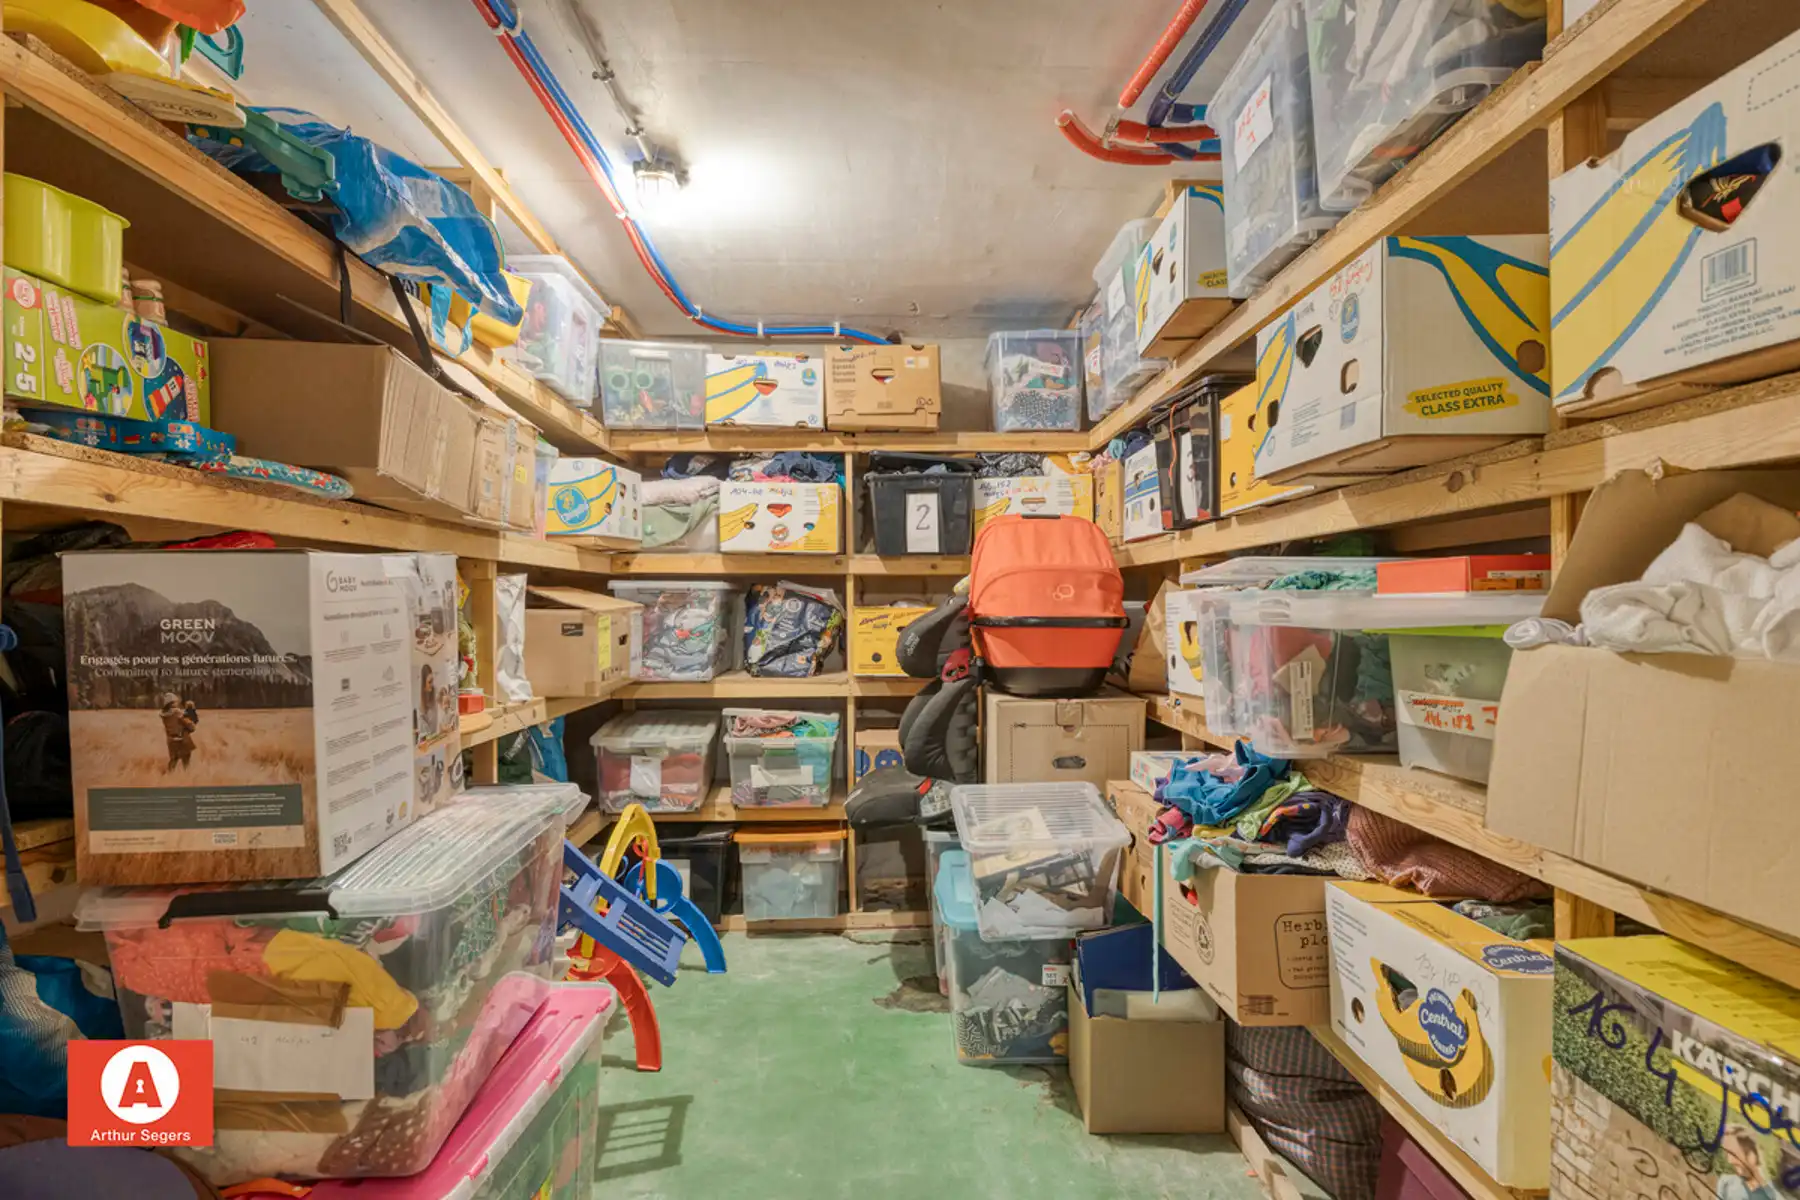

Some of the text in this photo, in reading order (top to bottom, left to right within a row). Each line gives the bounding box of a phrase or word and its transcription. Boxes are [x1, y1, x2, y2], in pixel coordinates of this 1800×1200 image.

[14, 341, 37, 393] 2-5
[1415, 382, 1504, 403] SELECTED QUALITY
[1421, 394, 1505, 416] CLASS EXTRA
[916, 504, 931, 531] 2
[160, 618, 216, 631] GREEN
[80, 654, 131, 667] Engagés
[132, 656, 161, 667] pour
[163, 654, 180, 665] les
[182, 653, 251, 667] générations
[94, 667, 159, 678] Committed
[161, 667, 173, 678] to
[1487, 953, 1550, 969] Central
[1420, 1008, 1465, 1040] Central
